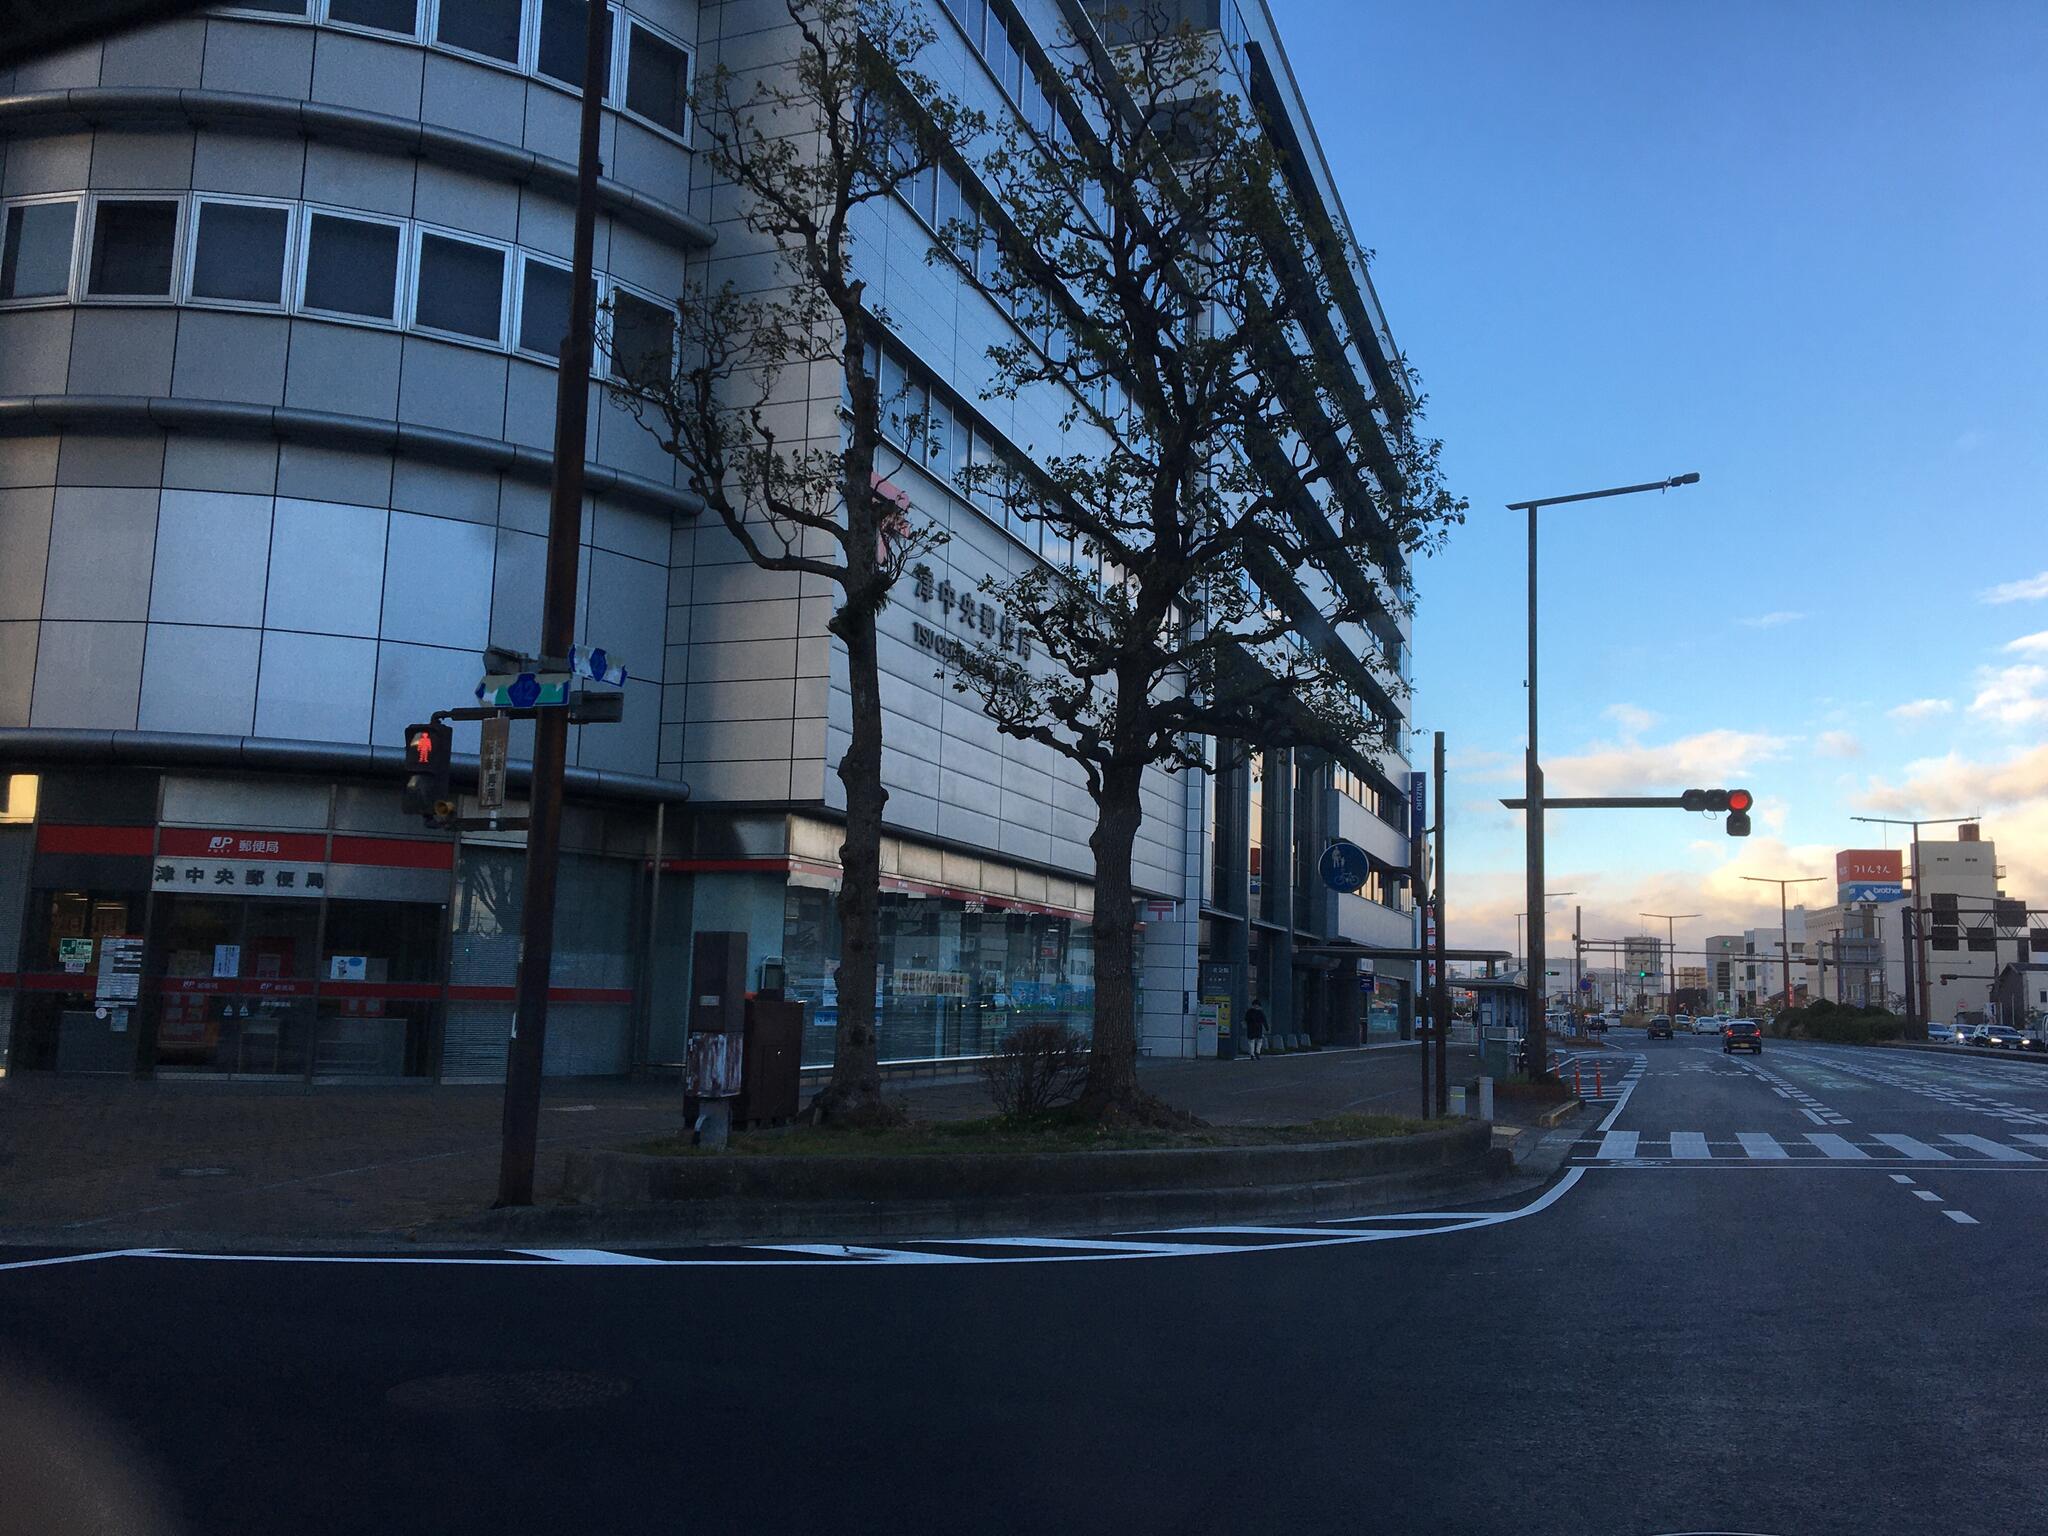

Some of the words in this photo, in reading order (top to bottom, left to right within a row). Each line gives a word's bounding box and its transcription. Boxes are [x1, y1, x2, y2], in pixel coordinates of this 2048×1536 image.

[239, 840, 279, 853] 郵便局
[155, 865, 324, 889] 津中央郵便局
[1873, 887, 1901, 895] brother
